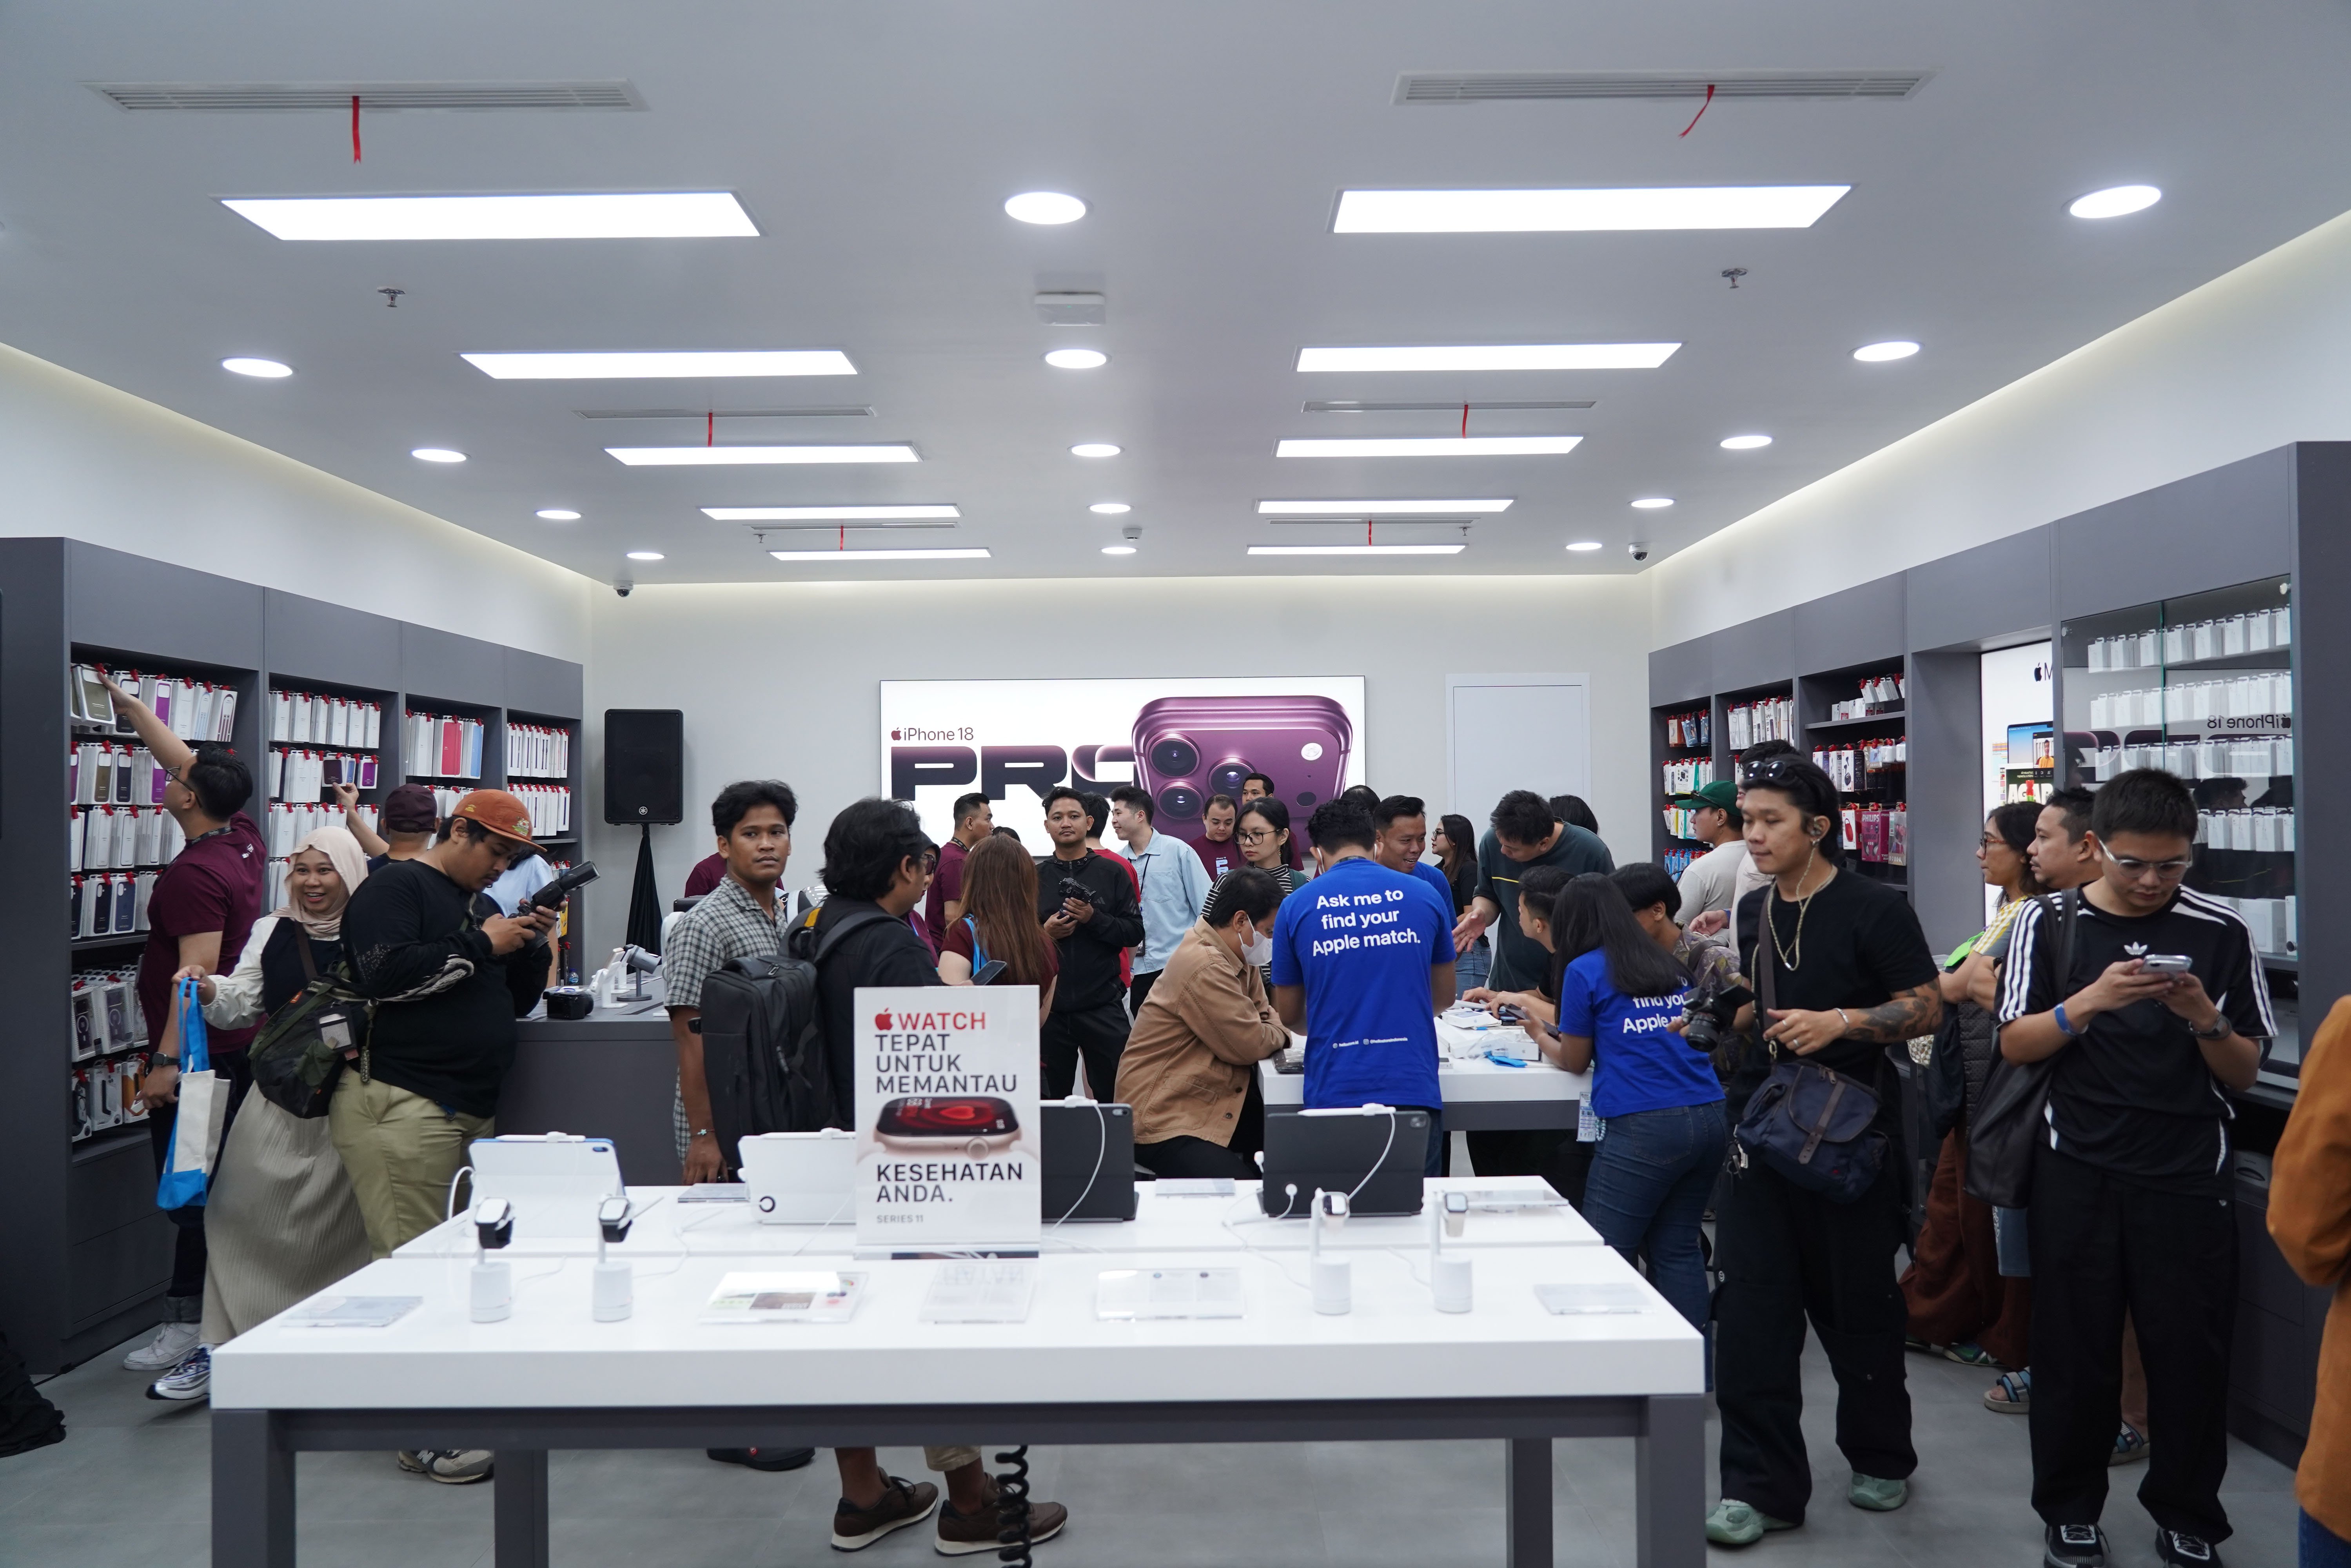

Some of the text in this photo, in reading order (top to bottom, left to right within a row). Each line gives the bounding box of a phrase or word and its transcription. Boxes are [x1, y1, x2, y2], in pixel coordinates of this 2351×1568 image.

[904, 727, 974, 742] iPhone 18
[1316, 889, 1403, 909] Ask me to
[1321, 910, 1400, 929] find your
[1313, 928, 1421, 956] Apple match.
[898, 1012, 986, 1030] WATCH
[1623, 1014, 1669, 1034] Apple
[875, 1034, 950, 1052] TEPAT
[877, 1054, 961, 1073] UNTUK
[877, 1074, 1017, 1093] MEMANTAU
[877, 1163, 1023, 1181] KESEHATAN
[877, 1185, 953, 1203] ANDA.
[877, 1214, 924, 1223] SERIES 11
